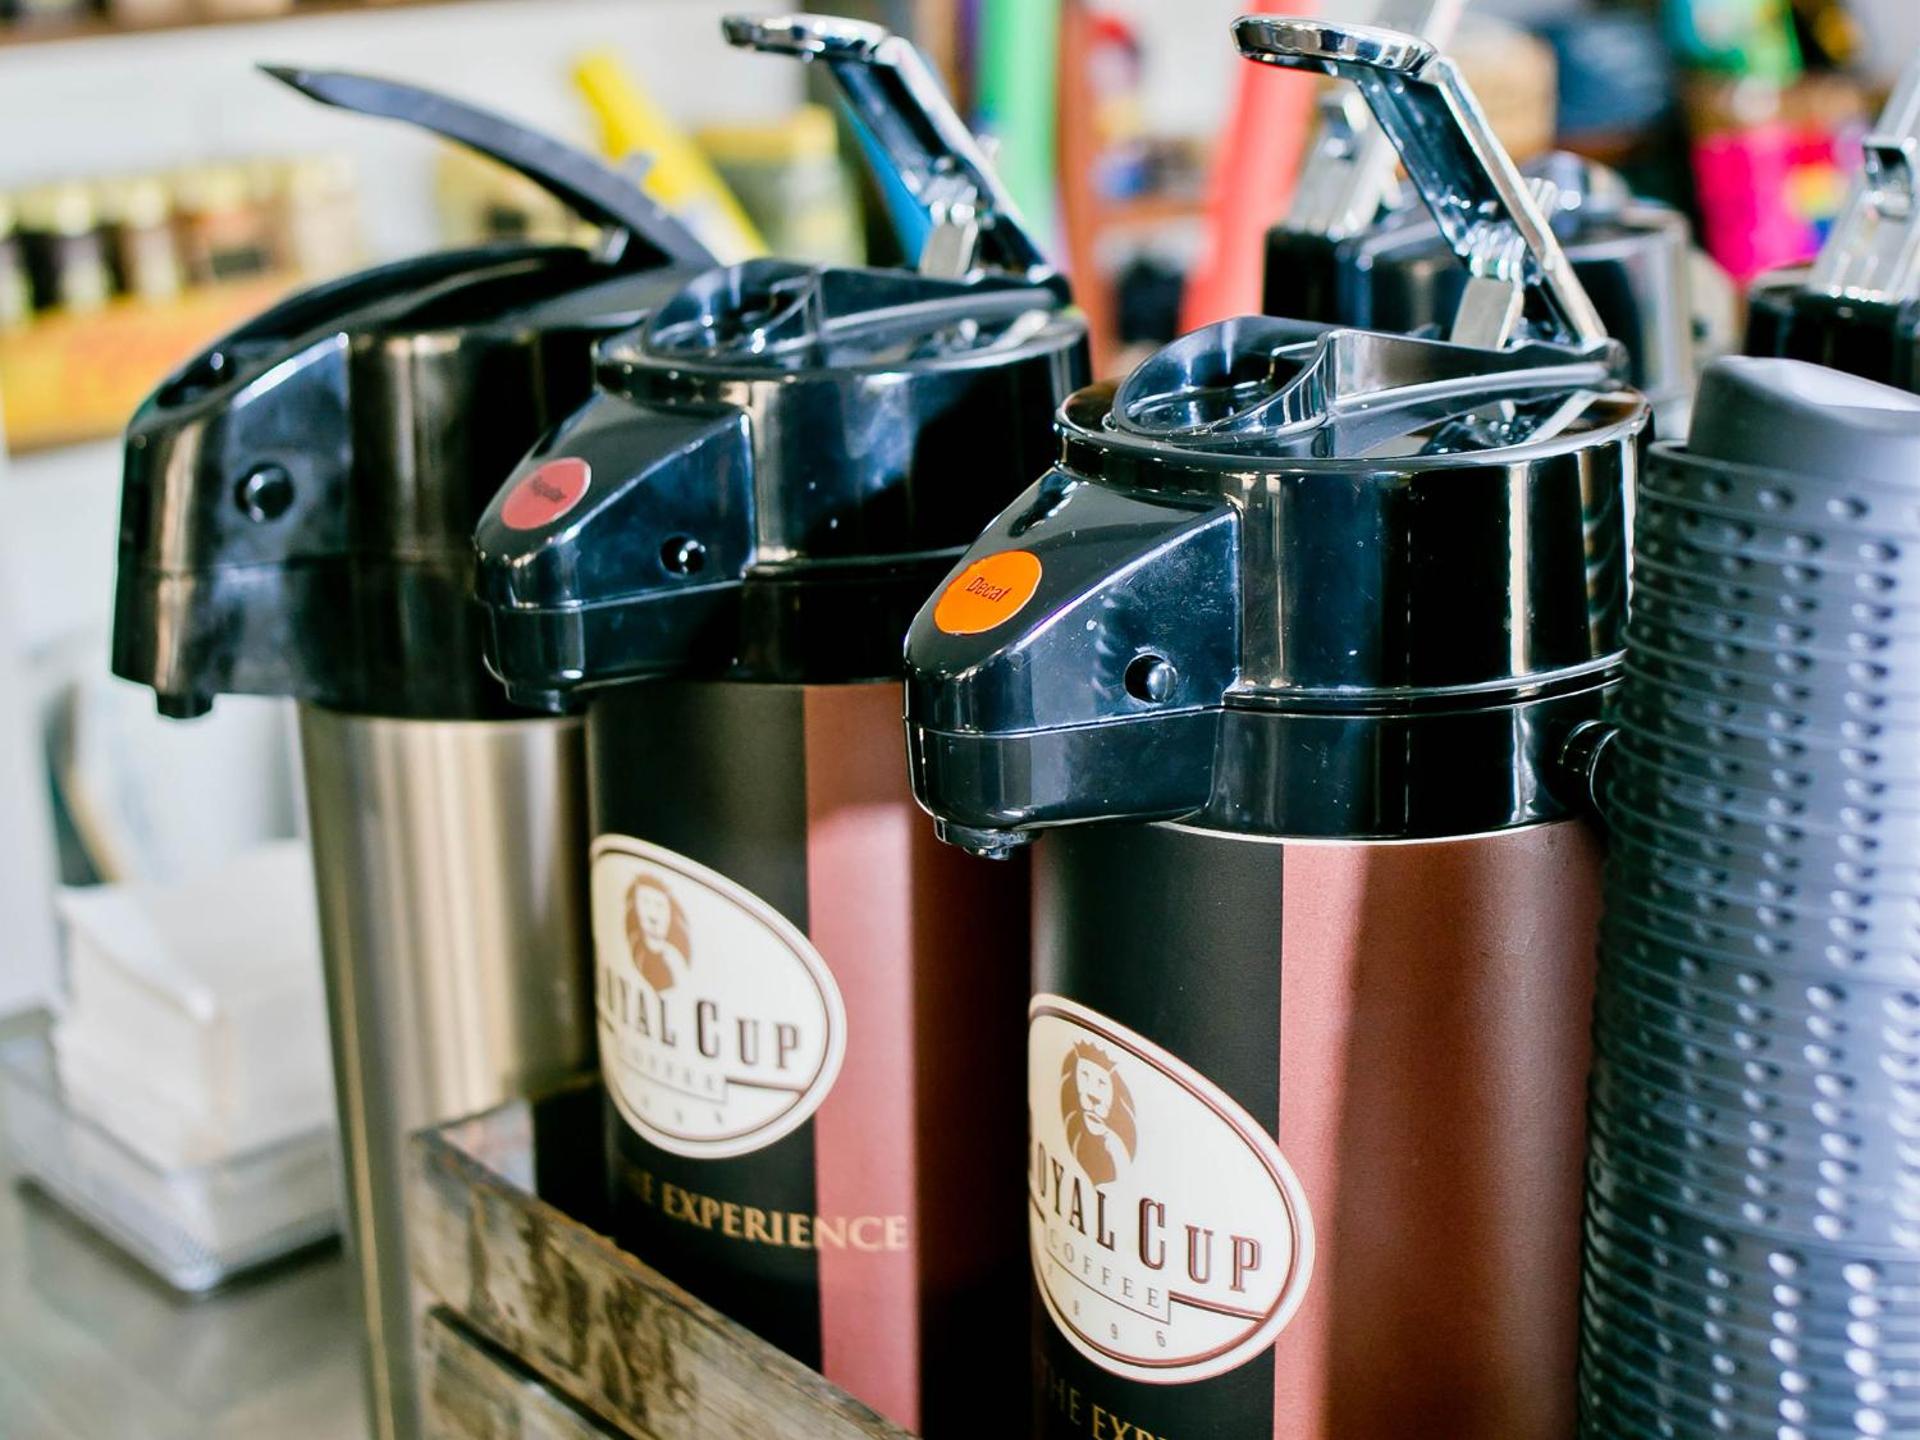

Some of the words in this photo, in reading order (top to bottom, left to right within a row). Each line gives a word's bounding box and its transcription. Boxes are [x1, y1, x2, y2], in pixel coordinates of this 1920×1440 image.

[965, 576, 1012, 603] Decaf
[696, 999, 799, 1069] CUP
[661, 1180, 909, 1252] EXPERIENCE
[1138, 1196, 1262, 1294] CUP
[1049, 1227, 1160, 1310] COFFEE
